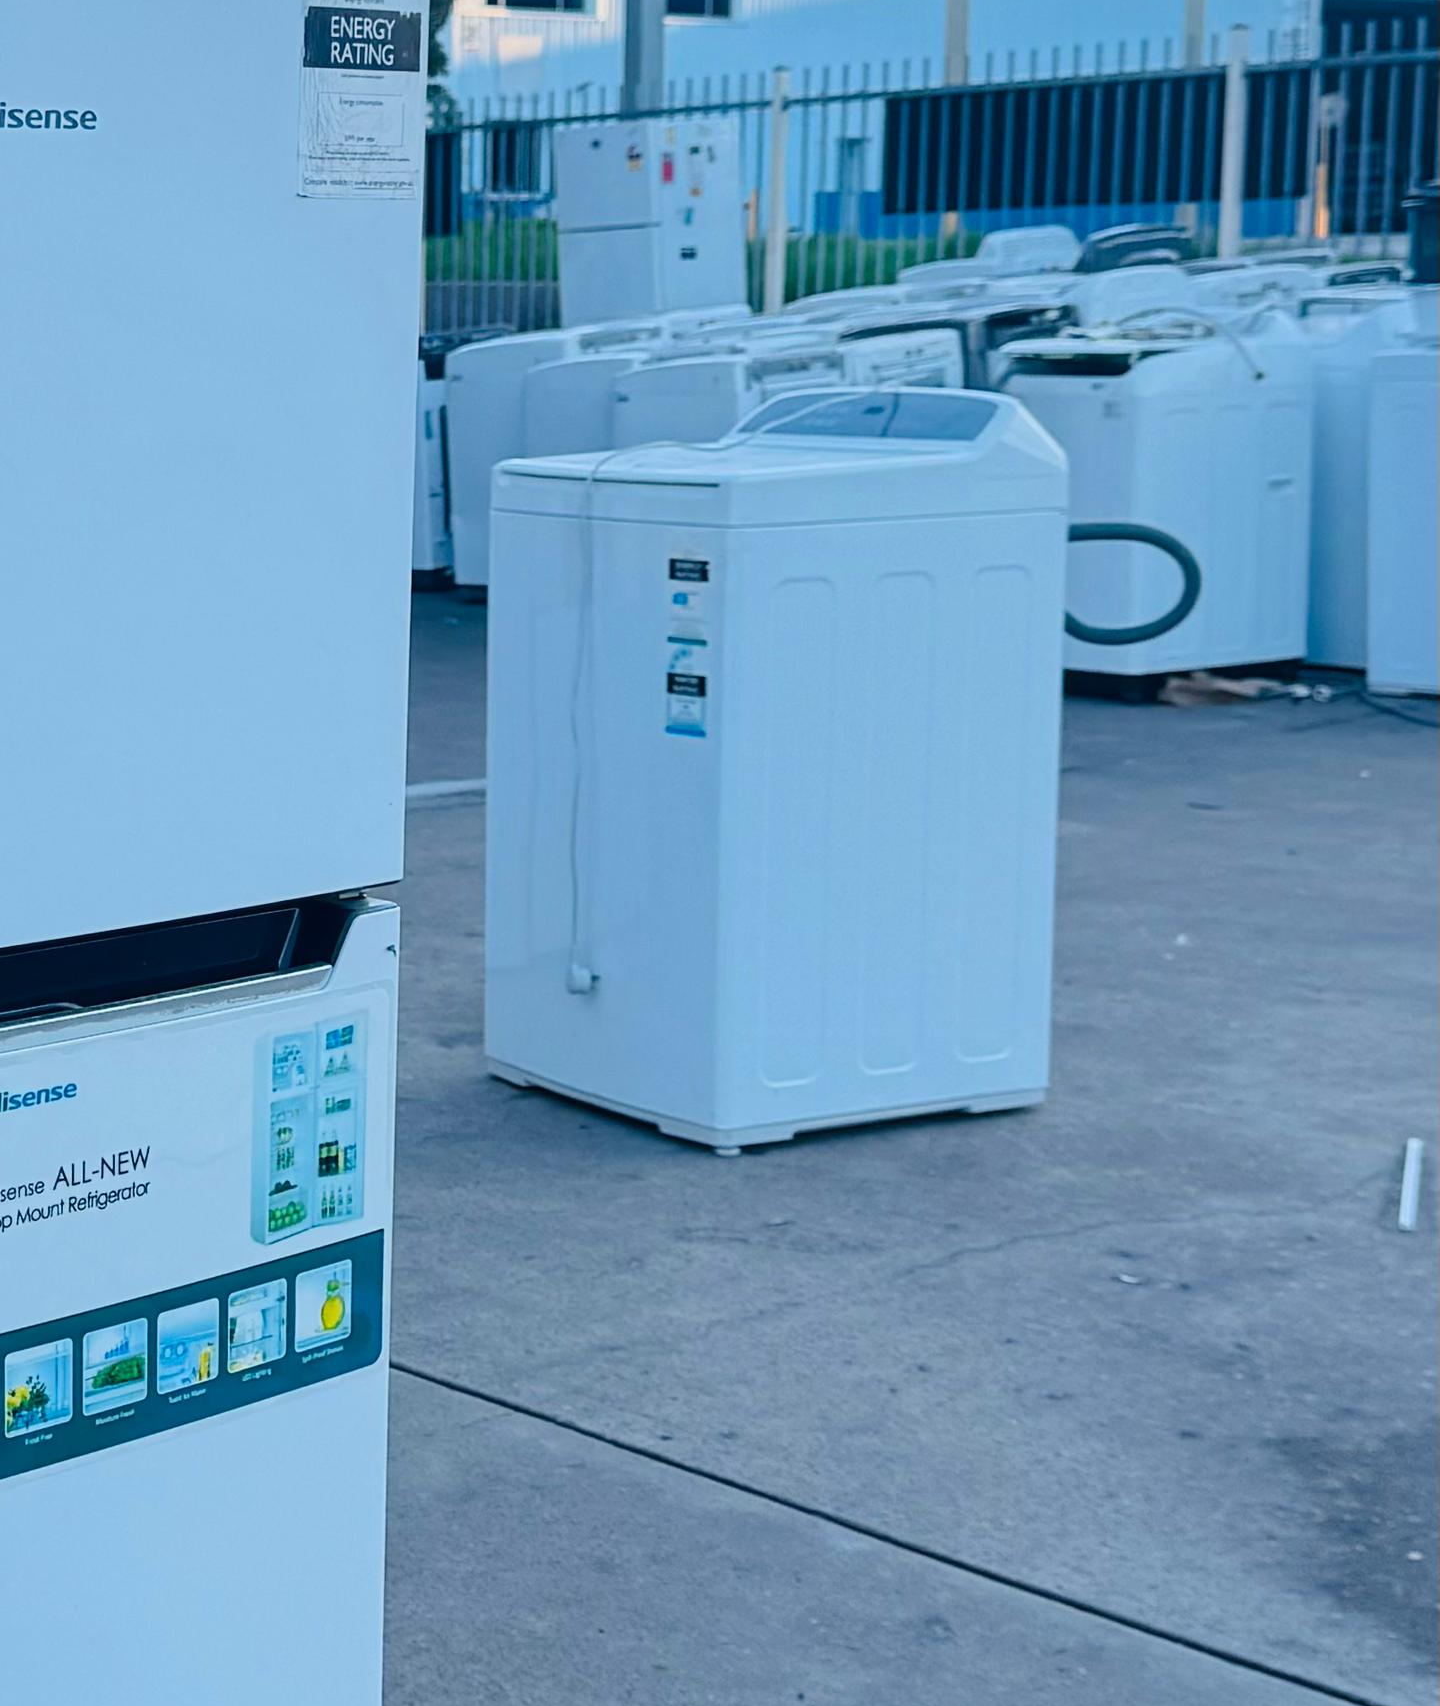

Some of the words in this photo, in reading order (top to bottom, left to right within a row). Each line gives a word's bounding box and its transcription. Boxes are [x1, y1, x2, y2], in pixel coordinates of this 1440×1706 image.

[330, 15, 396, 41] ENERGY
[330, 41, 395, 66] RATING
[53, 1145, 151, 1190] ALL-NEW
[16, 1198, 65, 1226] Mount
[68, 1181, 151, 1210] Refrigerator
